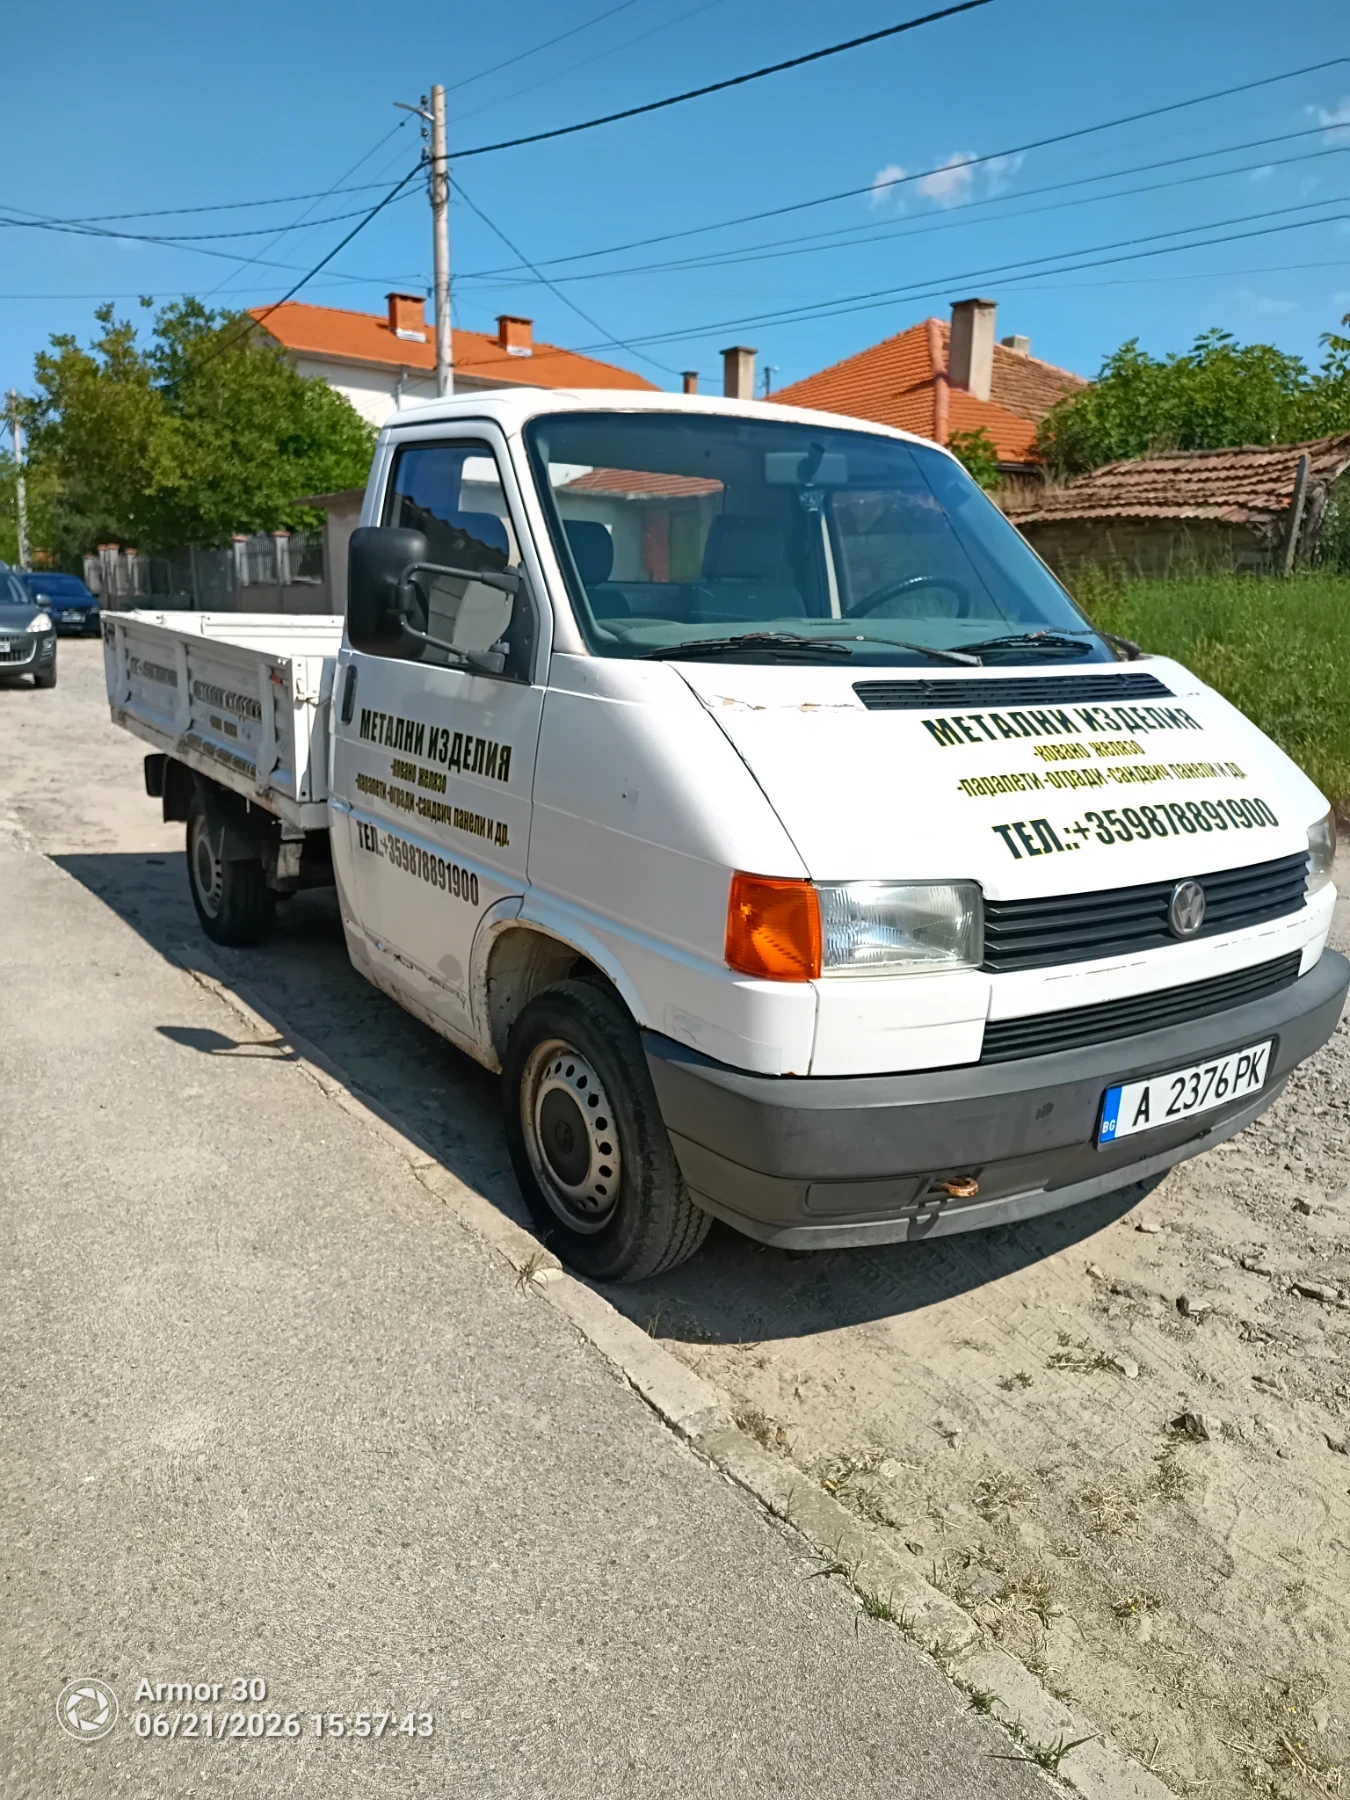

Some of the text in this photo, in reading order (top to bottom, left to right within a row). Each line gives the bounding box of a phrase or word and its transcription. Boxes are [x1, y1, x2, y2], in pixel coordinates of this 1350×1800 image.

[921, 706, 1204, 747] МЕТАЛНИ ИЗДЕЛИЯ
[360, 708, 512, 783] МЕТАЛНИ ИЗДЕЛИЯ
[1088, 740, 1146, 758] желязо
[1168, 763, 1221, 780] панели
[454, 806, 486, 838] панели
[1132, 1086, 1150, 1127] A
[1102, 1121, 1116, 1134] BG
